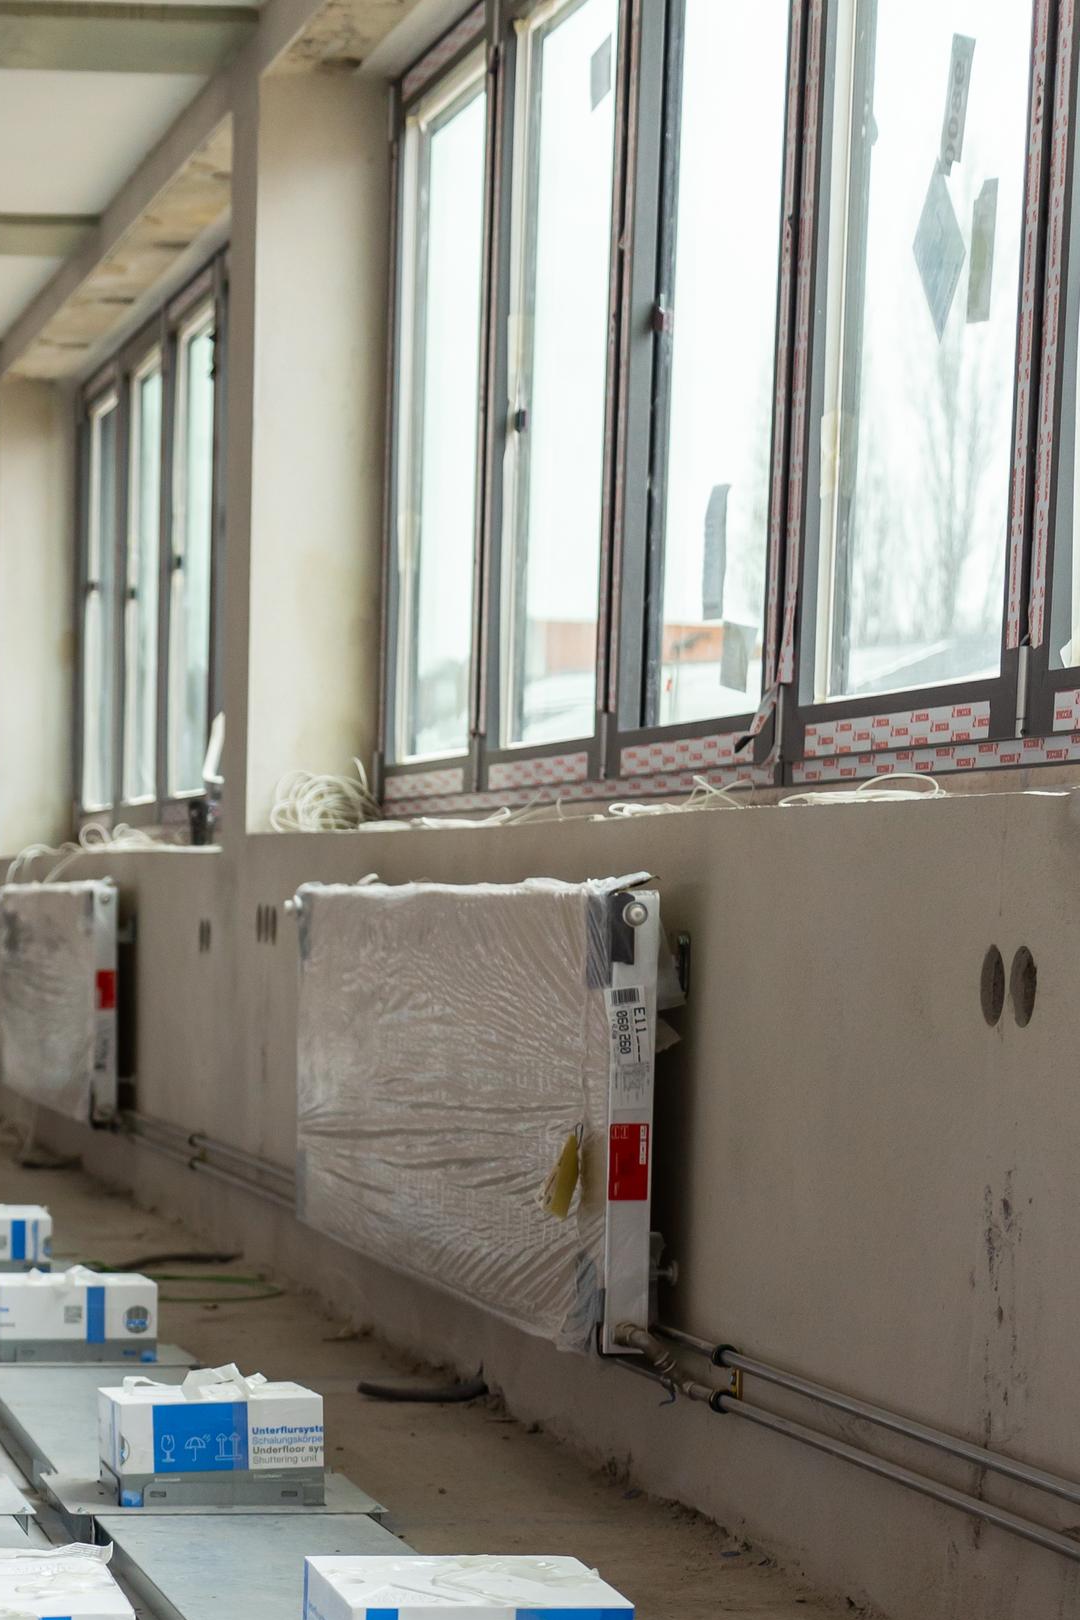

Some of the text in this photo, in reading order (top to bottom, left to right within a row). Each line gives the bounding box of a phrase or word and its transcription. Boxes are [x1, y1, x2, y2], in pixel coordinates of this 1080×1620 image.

[252, 1445, 305, 1455] Underfloor
[252, 1454, 316, 1465] Shuttering unit
